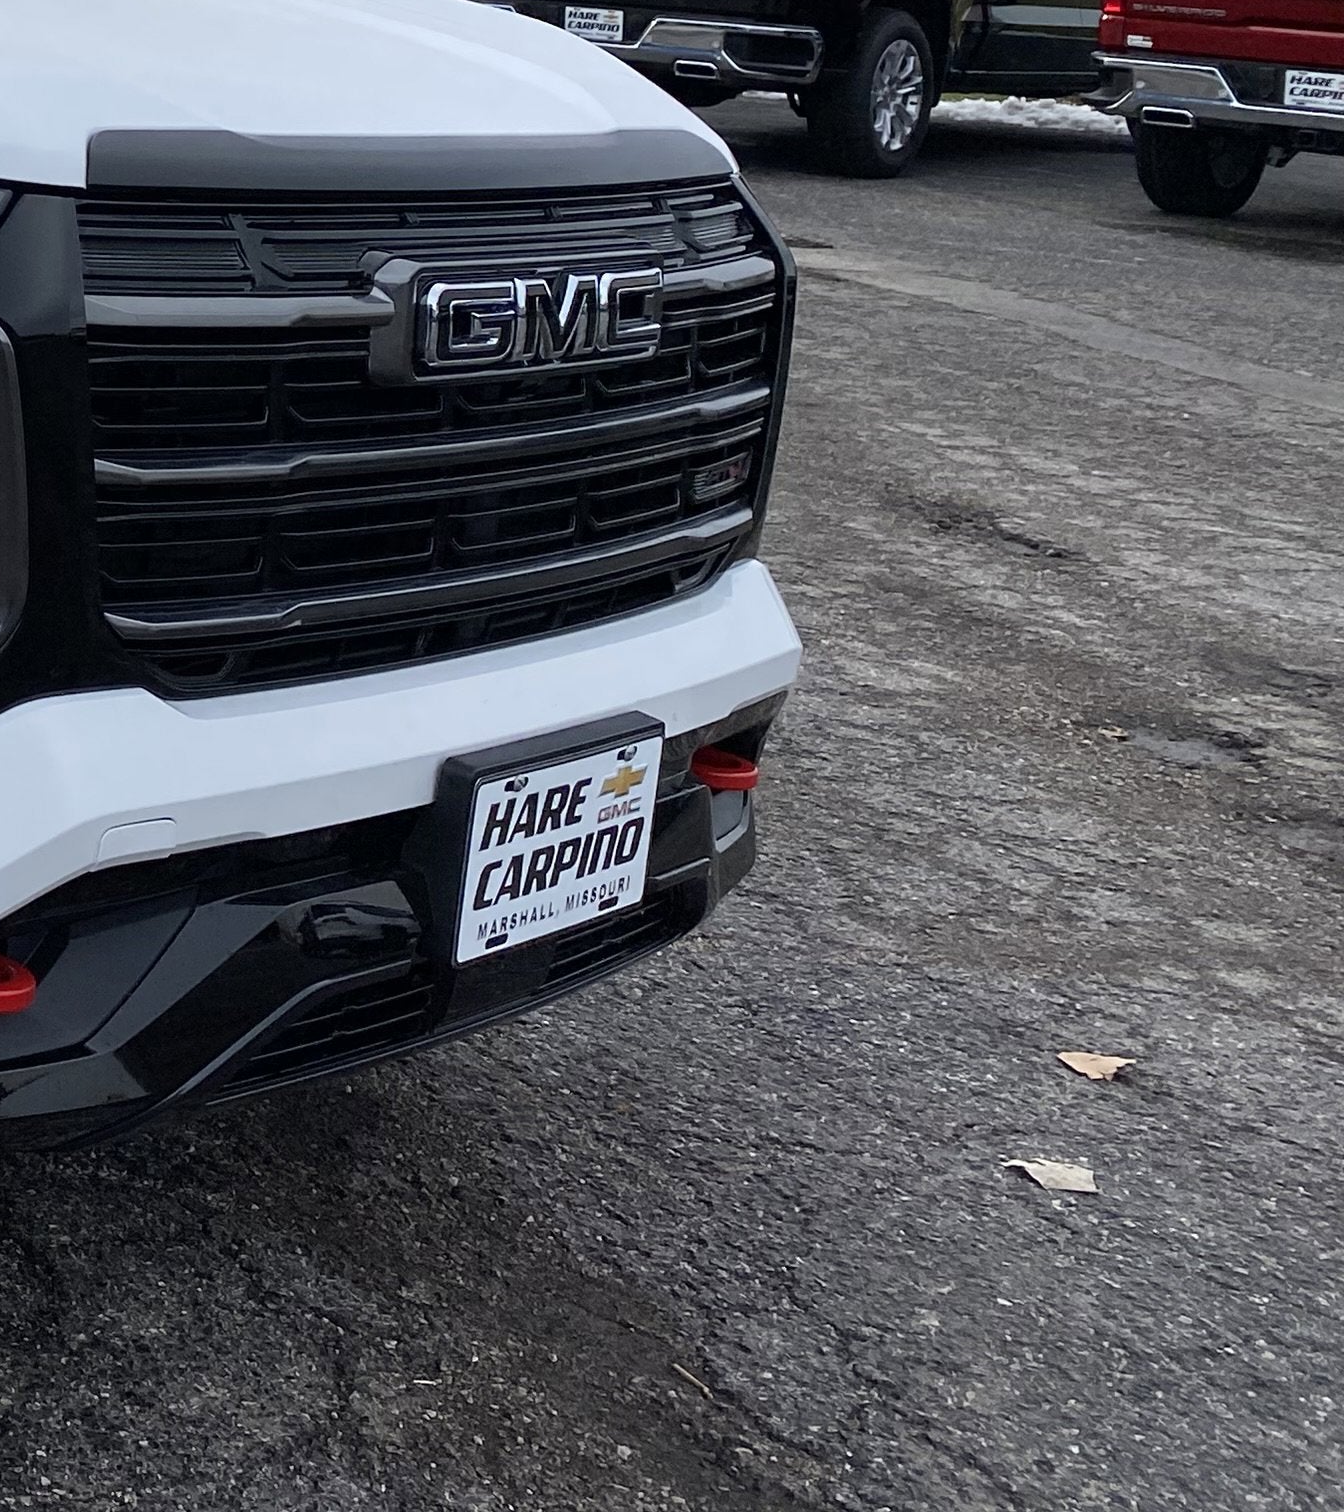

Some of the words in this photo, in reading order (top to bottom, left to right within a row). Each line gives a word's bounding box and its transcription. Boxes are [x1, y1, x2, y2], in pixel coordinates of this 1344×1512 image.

[568, 10, 600, 21] HARE
[1290, 75, 1336, 87] HARE
[424, 267, 663, 367] GMC
[479, 777, 593, 851] HARE
[598, 796, 642, 824] GMC
[473, 816, 645, 911] CARPINO
[477, 901, 560, 939] MARSHALL,
[566, 875, 631, 911] MISSOURI
